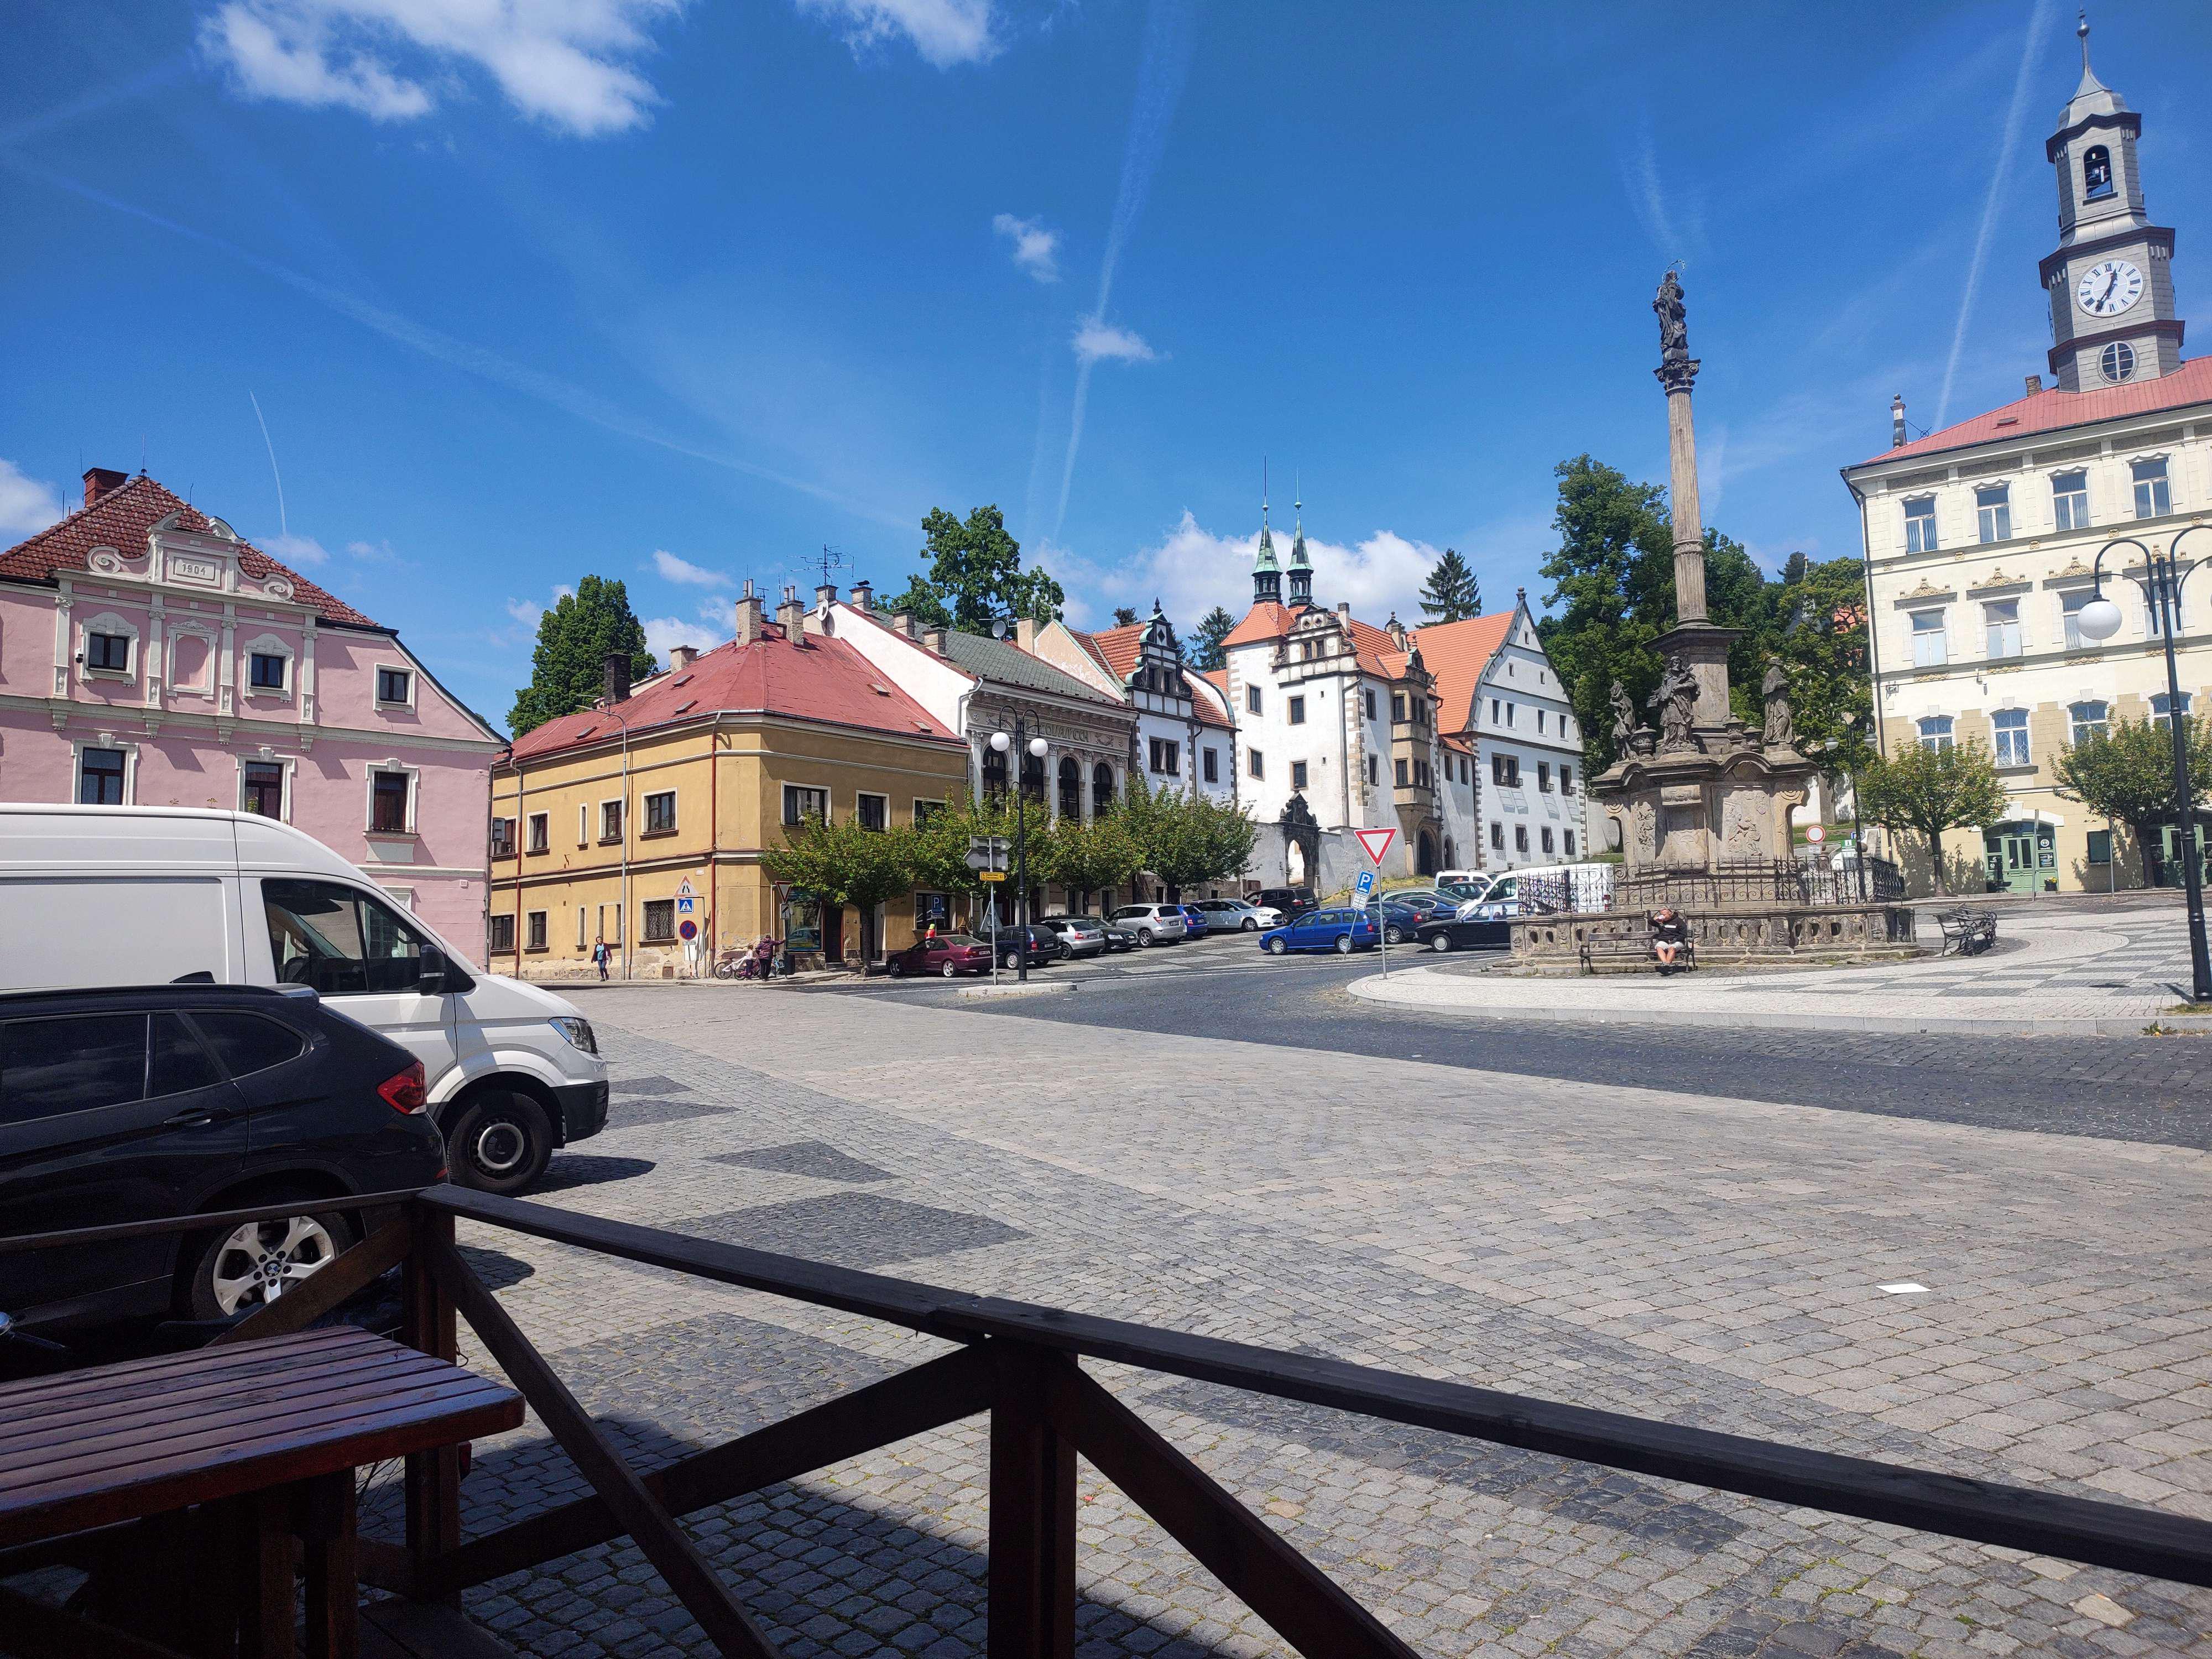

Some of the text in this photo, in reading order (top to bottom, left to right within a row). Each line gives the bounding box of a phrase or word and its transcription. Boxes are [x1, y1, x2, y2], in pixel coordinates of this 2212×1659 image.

[182, 564, 206, 576] 1904
[1360, 873, 1371, 886] P
[933, 897, 940, 908] P
